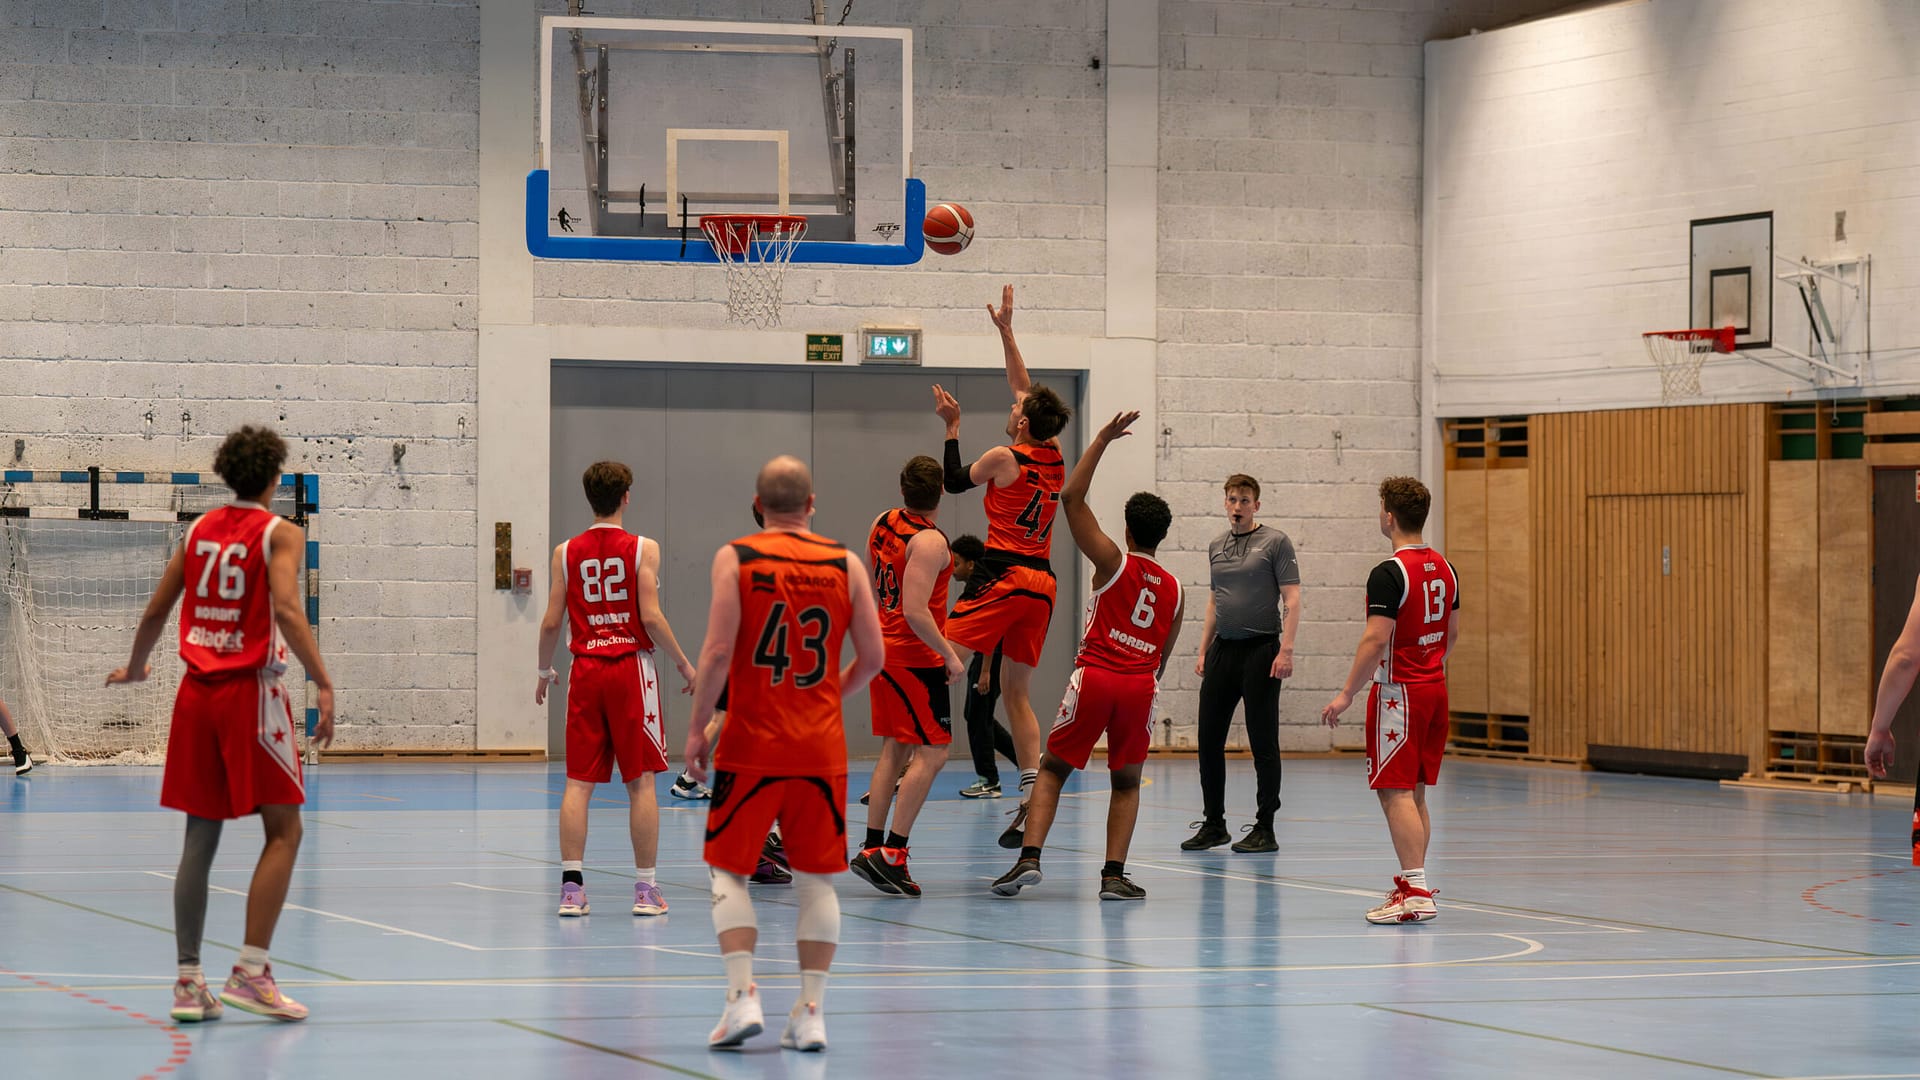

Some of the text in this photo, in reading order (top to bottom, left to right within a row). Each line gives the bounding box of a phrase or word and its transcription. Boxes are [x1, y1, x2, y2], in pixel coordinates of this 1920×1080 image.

[823, 352, 841, 360] EXIT
[1015, 488, 1060, 543] 47
[195, 539, 248, 600] 76
[580, 557, 628, 603] 82
[1131, 587, 1156, 629] 6
[1422, 579, 1446, 624] 13
[185, 626, 246, 650] Bladet
[752, 601, 831, 689] 43
[1108, 628, 1157, 654] NORBIT
